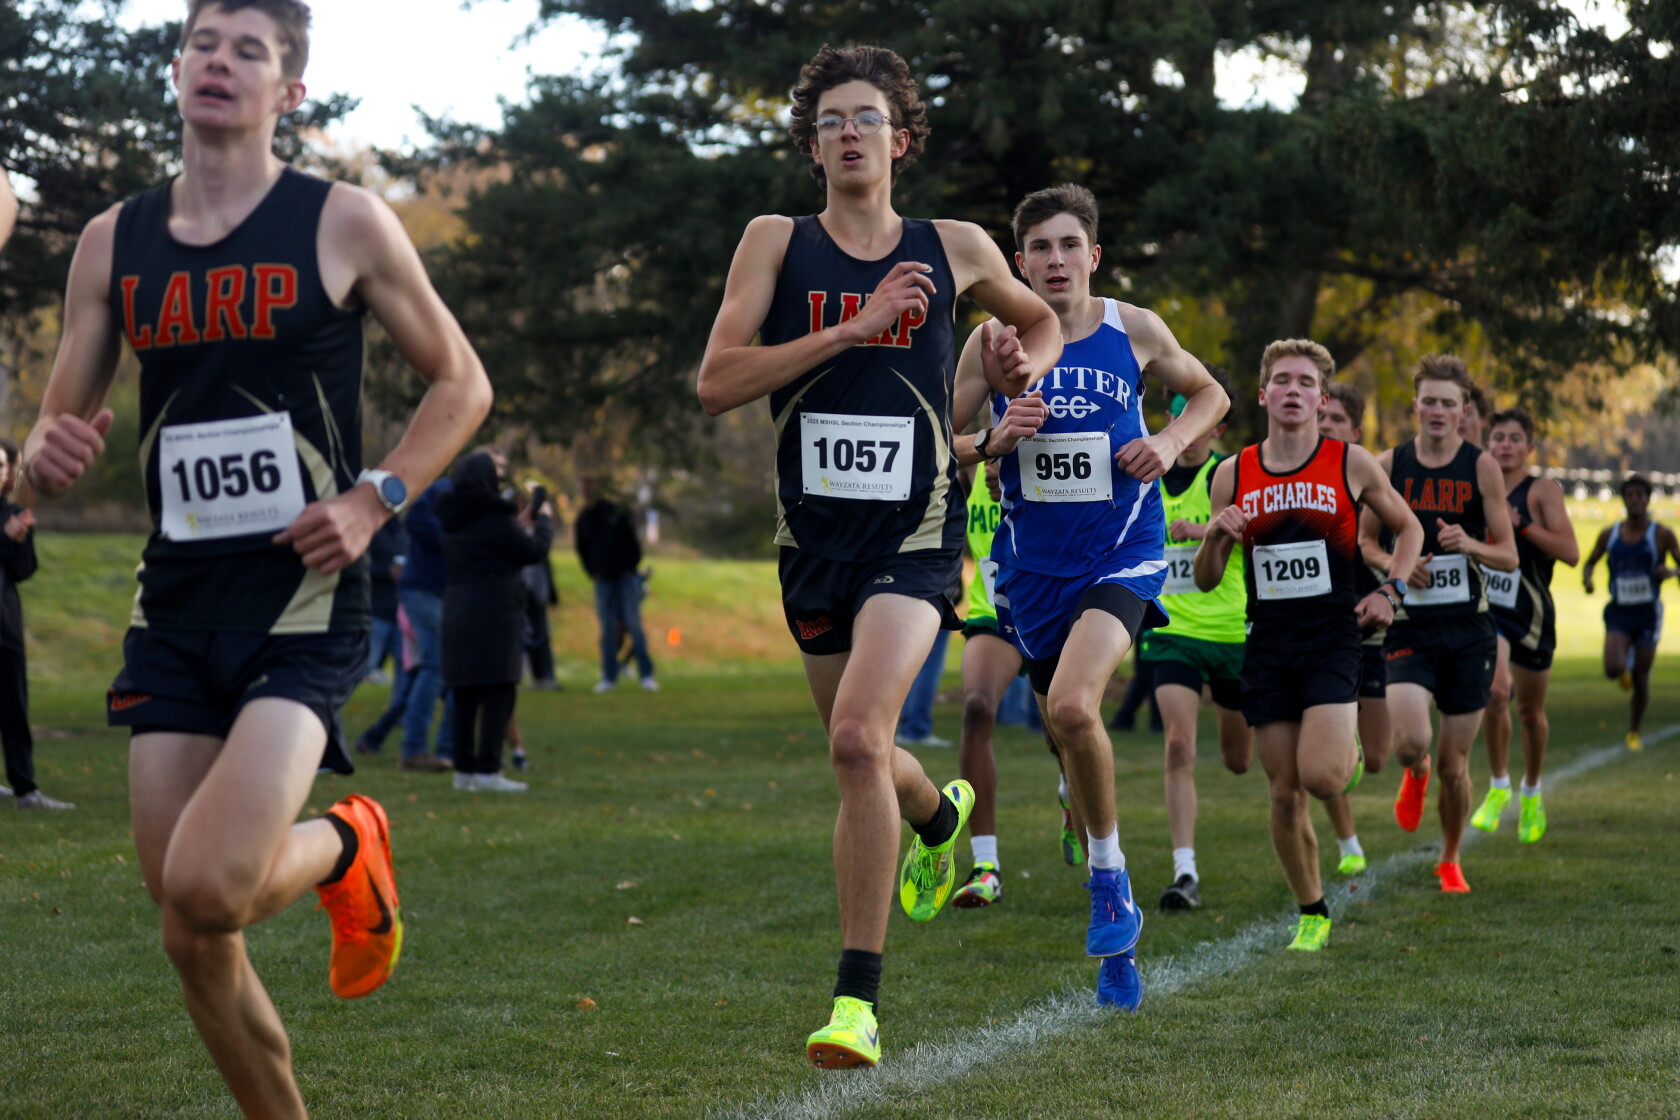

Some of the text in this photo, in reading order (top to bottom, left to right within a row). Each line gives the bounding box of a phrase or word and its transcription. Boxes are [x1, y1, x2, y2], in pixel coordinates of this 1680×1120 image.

[121, 263, 298, 350] LARP
[1005, 366, 1131, 411] TTER
[820, 418, 840, 426] MSHSL
[863, 421, 907, 429] Championships
[1067, 435, 1104, 443] Championships
[813, 437, 901, 473] 1057
[1035, 452, 1092, 481] 956
[172, 448, 282, 503] 1056
[828, 480, 861, 490] WAYZATA
[862, 483, 894, 491] RESULTS
[1242, 482, 1337, 517] ST CHARLES
[1404, 478, 1472, 514] LARP
[1169, 560, 1194, 578] 12
[1261, 556, 1321, 582] 1209
